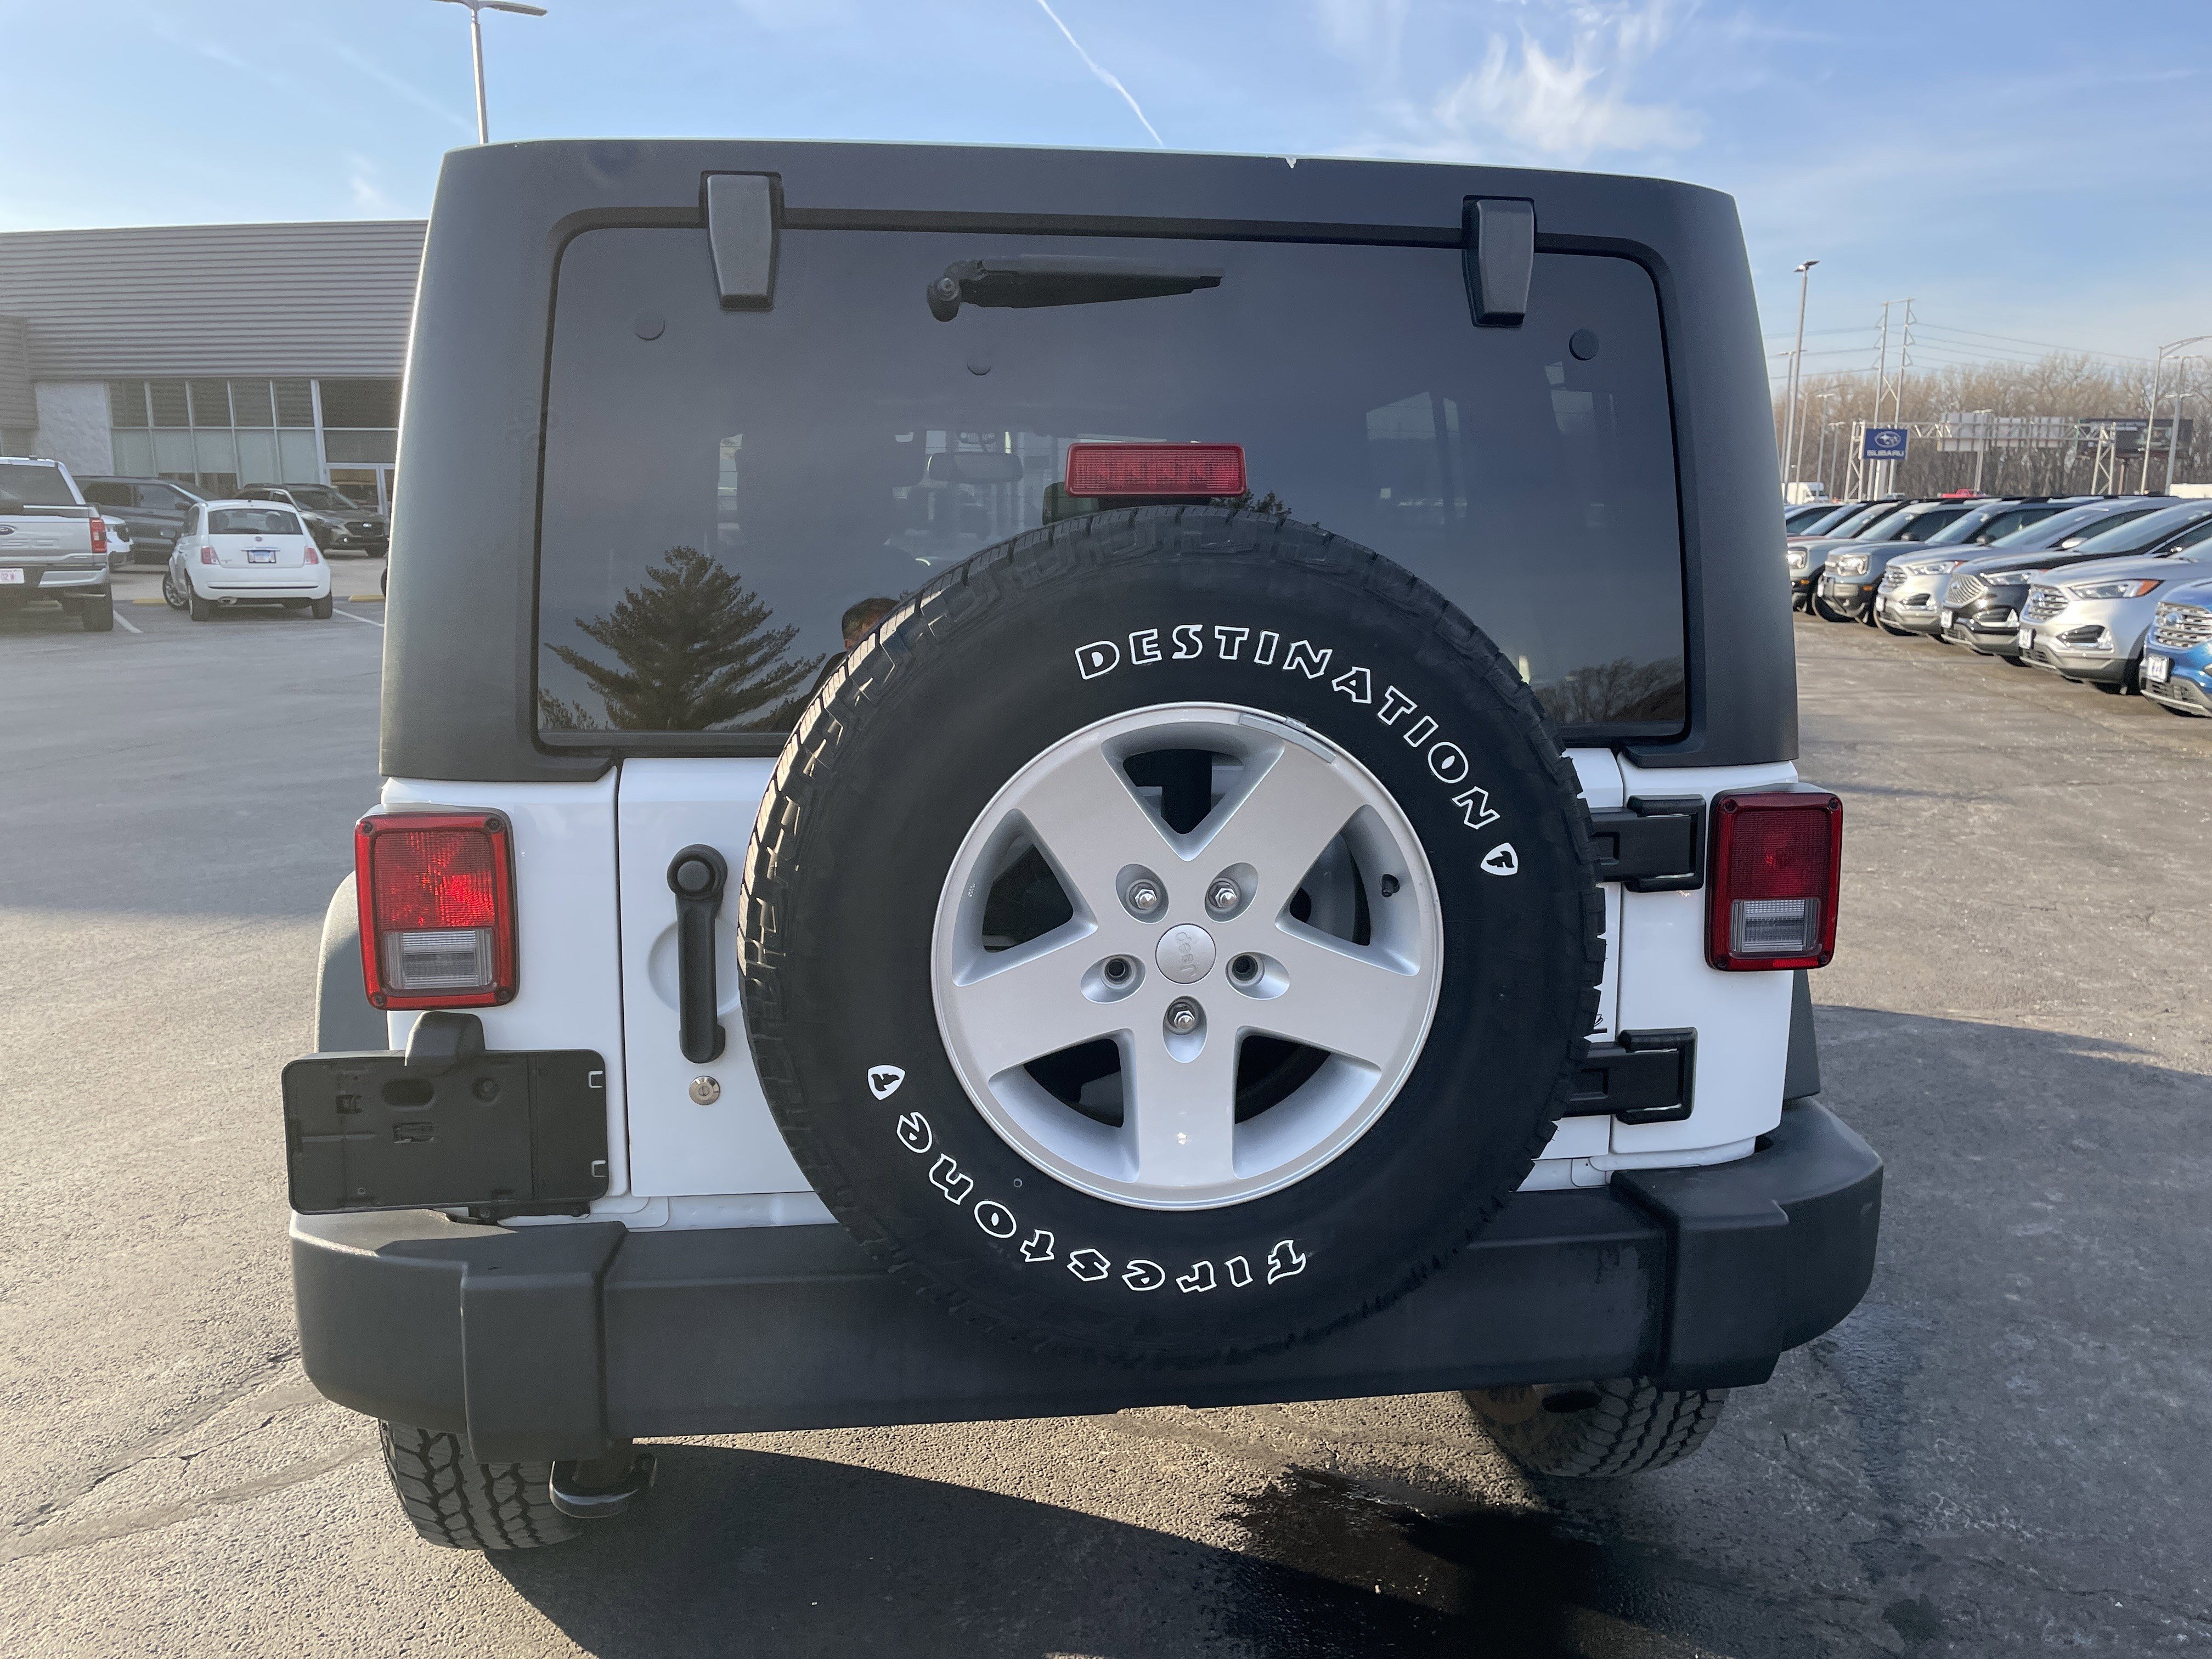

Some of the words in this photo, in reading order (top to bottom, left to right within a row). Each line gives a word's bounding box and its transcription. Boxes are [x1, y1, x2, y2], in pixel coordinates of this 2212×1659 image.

[1074, 624, 1500, 830] DESTINATION
[1175, 932, 1197, 977] Jeep
[896, 1111, 1306, 1293] Firestone
